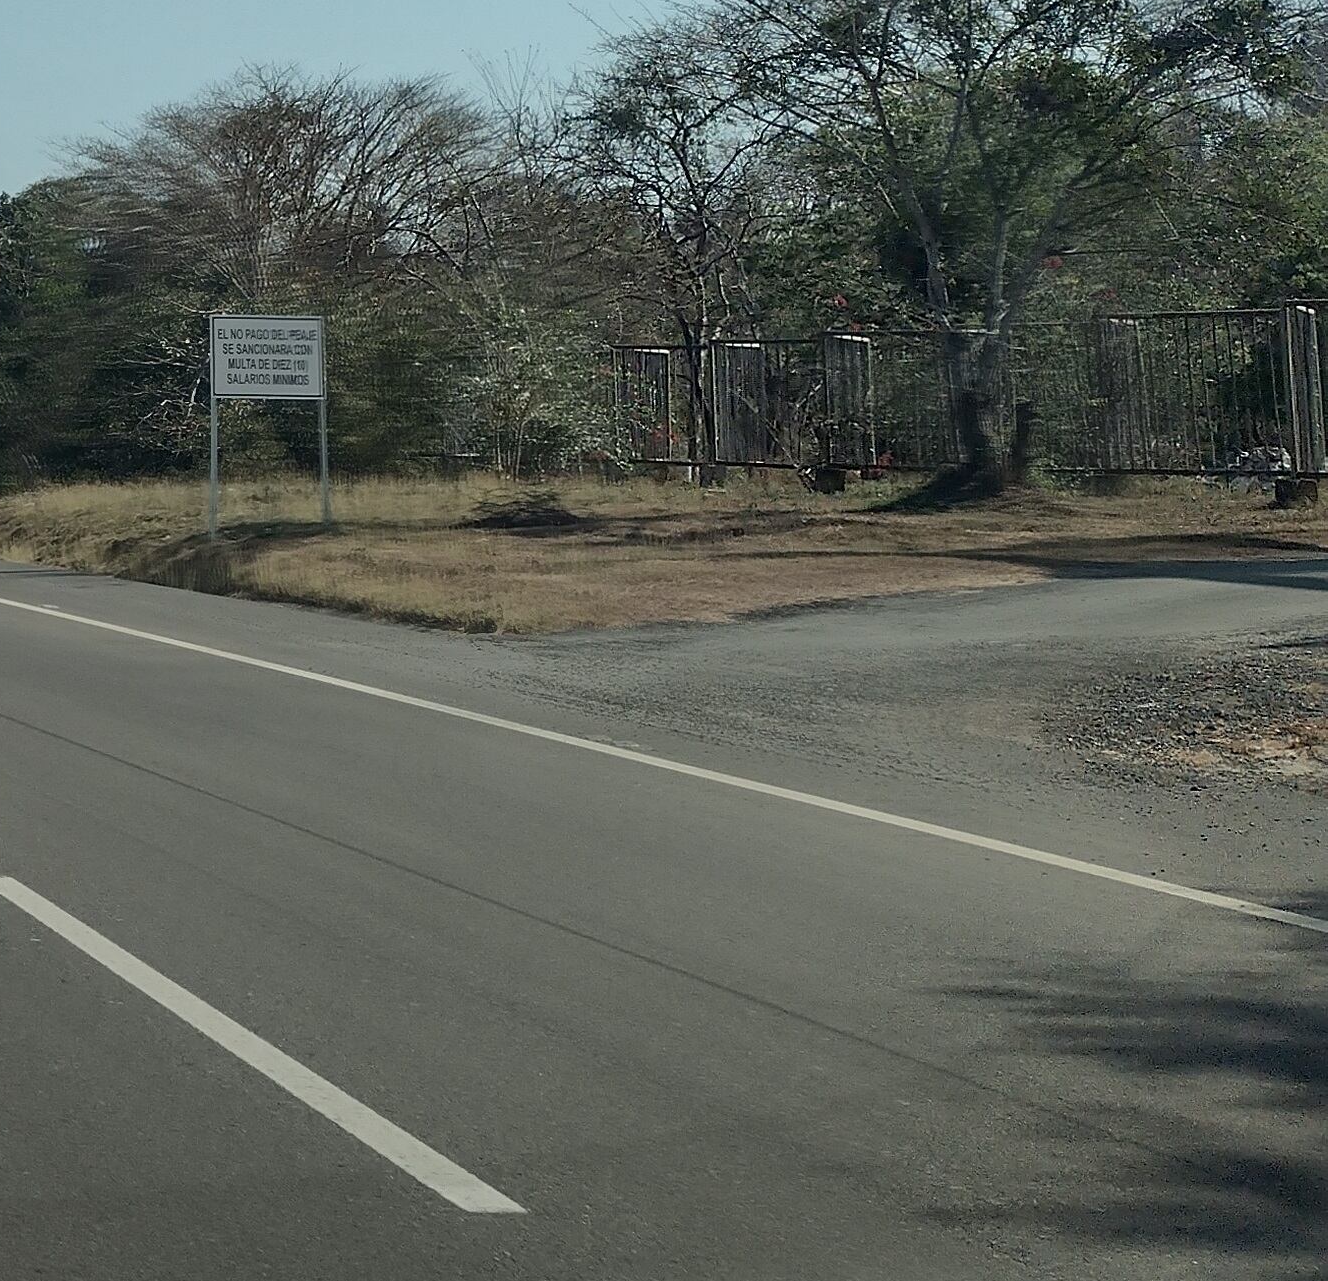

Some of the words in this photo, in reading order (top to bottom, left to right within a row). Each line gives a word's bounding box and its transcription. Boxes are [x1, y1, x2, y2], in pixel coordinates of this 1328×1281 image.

[217, 329, 228, 340] EL
[230, 329, 243, 340] NO
[245, 329, 269, 340] PAGO
[222, 343, 234, 355] SE
[228, 358, 256, 370] MULTA
[258, 358, 270, 370] DE
[272, 359, 292, 371] DIEZ
[226, 373, 271, 385] SALARIOS
